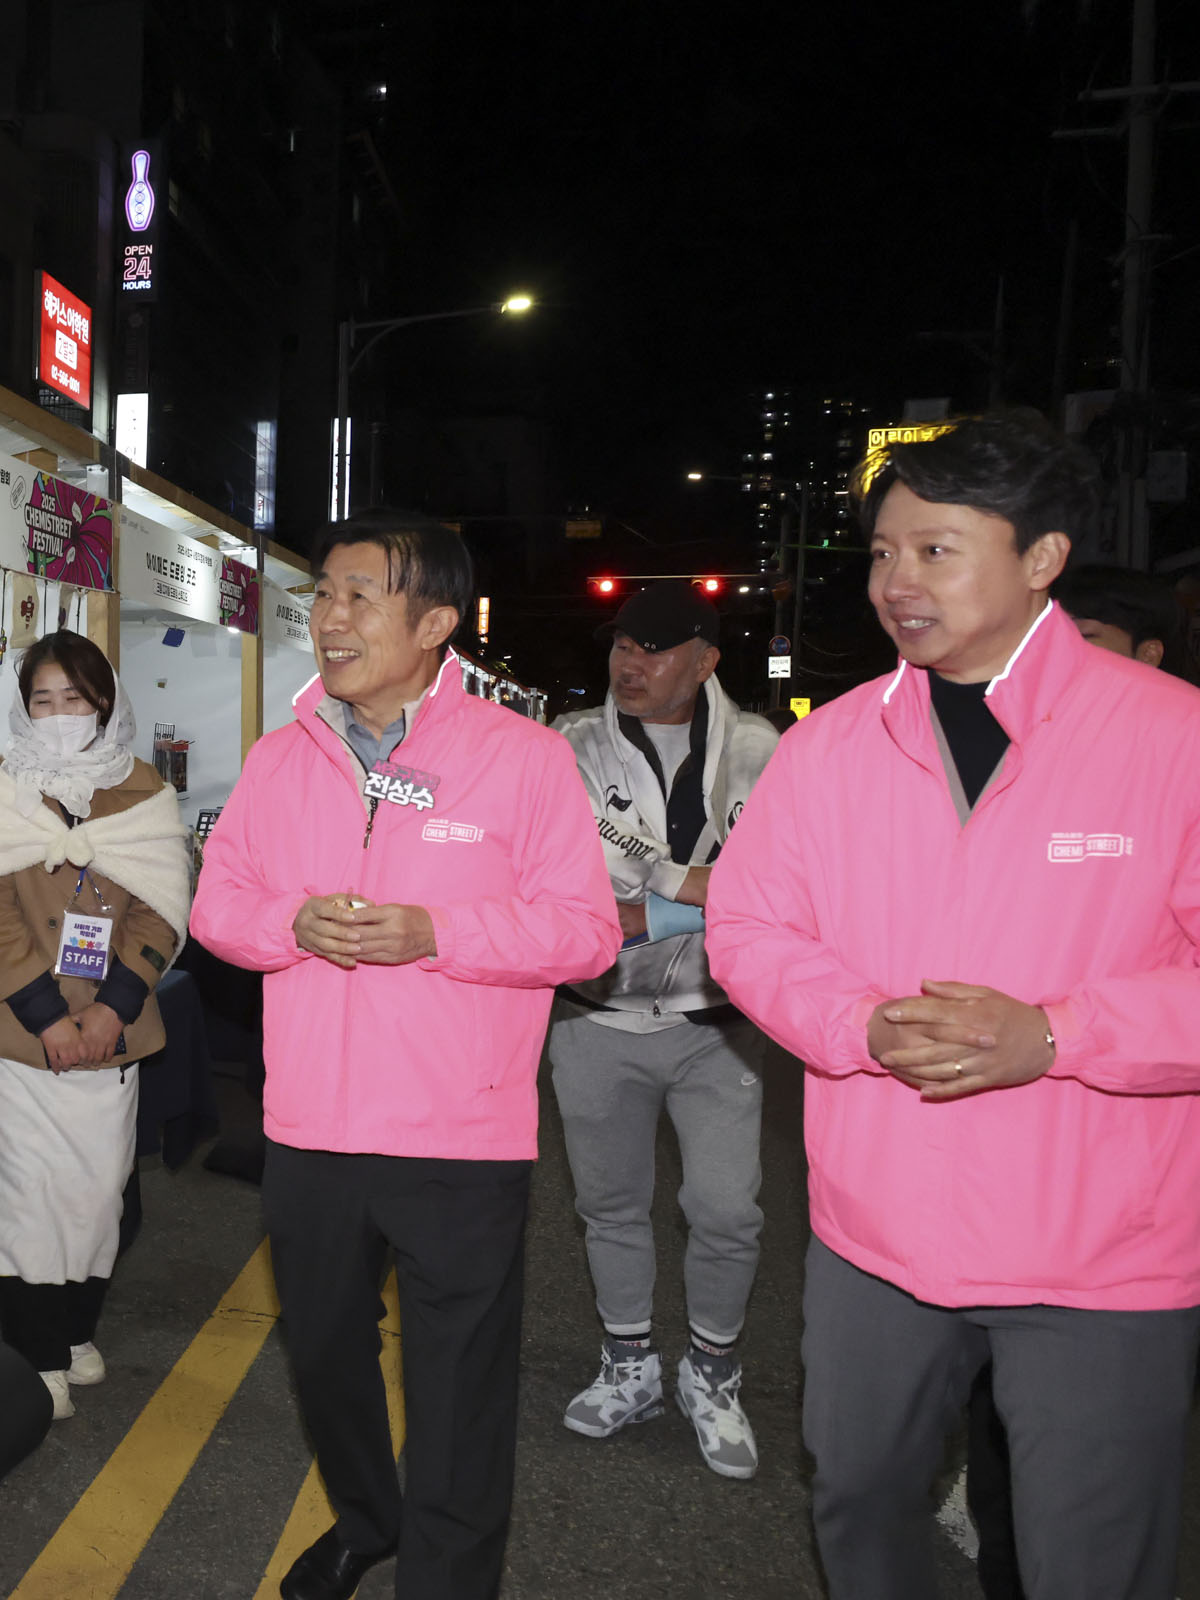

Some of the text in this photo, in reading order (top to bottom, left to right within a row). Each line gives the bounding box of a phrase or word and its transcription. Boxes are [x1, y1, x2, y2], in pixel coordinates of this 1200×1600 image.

[125, 245, 153, 256] OPEN
[124, 256, 151, 281] 24
[123, 280, 151, 291] HOURS
[44, 289, 89, 345] 해커스어학원
[41, 493, 56, 512] 2025
[25, 505, 73, 539] CHEMISTREET
[32, 529, 64, 557] FESTIVAL
[363, 771, 435, 812] 전성수
[449, 826, 475, 839] STREET
[64, 951, 104, 967] STAFF
